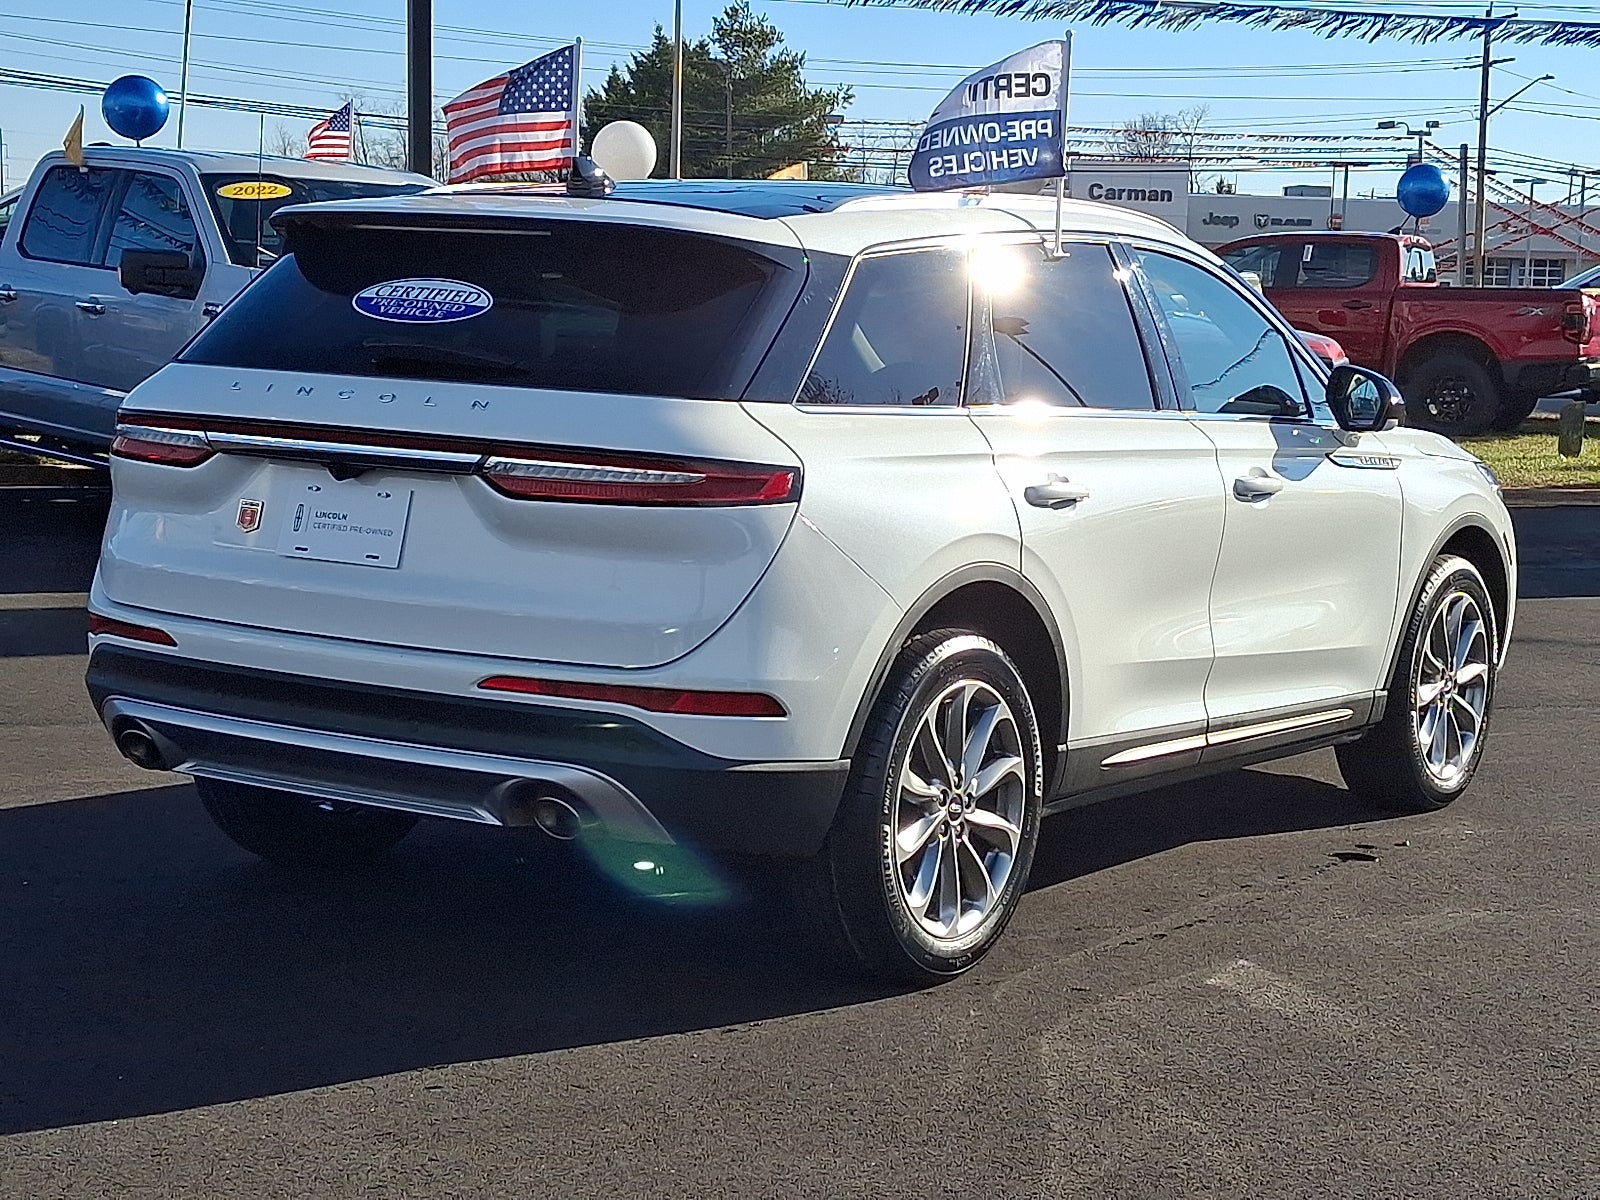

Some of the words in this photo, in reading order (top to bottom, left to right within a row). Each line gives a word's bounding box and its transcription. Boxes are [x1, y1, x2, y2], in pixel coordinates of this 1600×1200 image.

[232, 185, 279, 196] 2022
[1088, 182, 1173, 203] Carman
[1202, 212, 1240, 228] Jeep
[1270, 217, 1313, 227] RAM
[374, 285, 482, 304] CERTIFIED
[369, 297, 466, 313] PRE-OWNED
[378, 305, 447, 319] VEHICLE
[230, 380, 490, 411] LINCOLN
[315, 510, 348, 521] LINCOLN
[312, 521, 348, 533] CERTIFIED
[349, 525, 394, 538] PRE-OWNED
